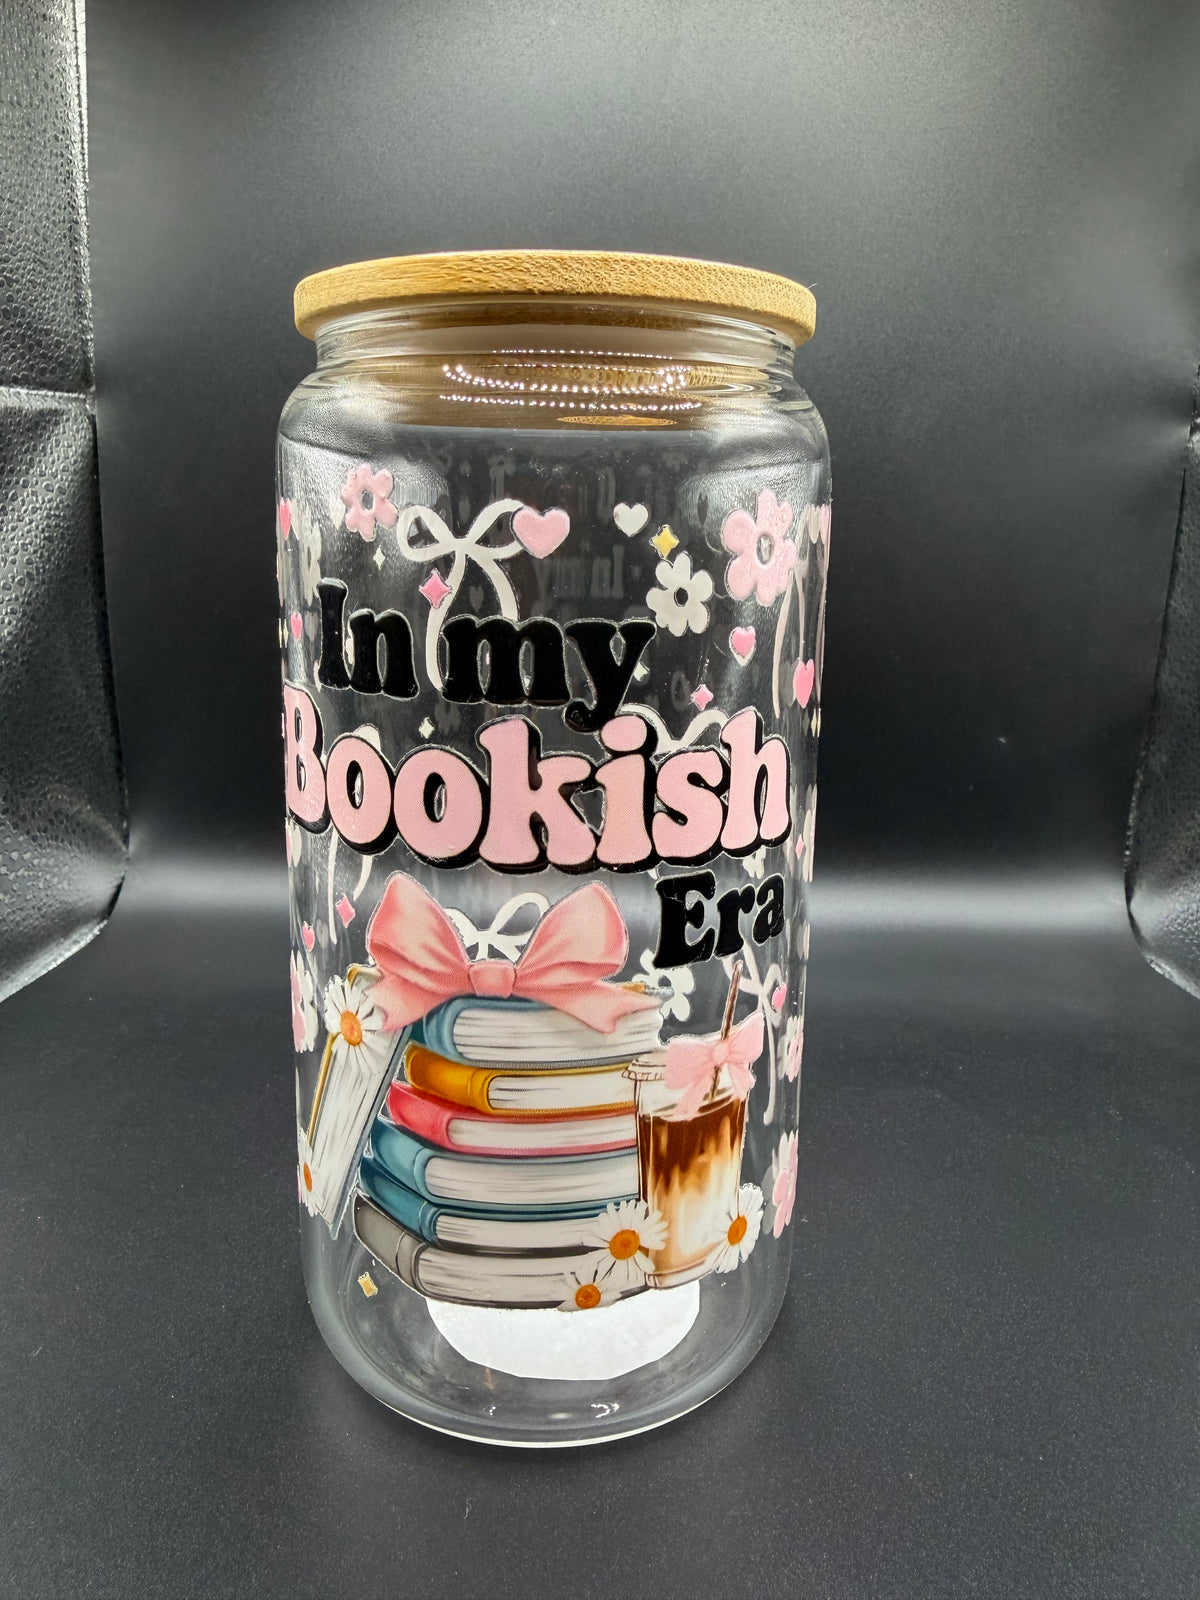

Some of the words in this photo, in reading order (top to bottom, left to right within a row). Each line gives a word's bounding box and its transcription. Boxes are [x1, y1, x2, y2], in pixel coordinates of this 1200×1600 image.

[317, 577, 418, 699] In
[440, 614, 657, 732] my
[283, 681, 791, 874] Bookish
[652, 869, 786, 968] Era
